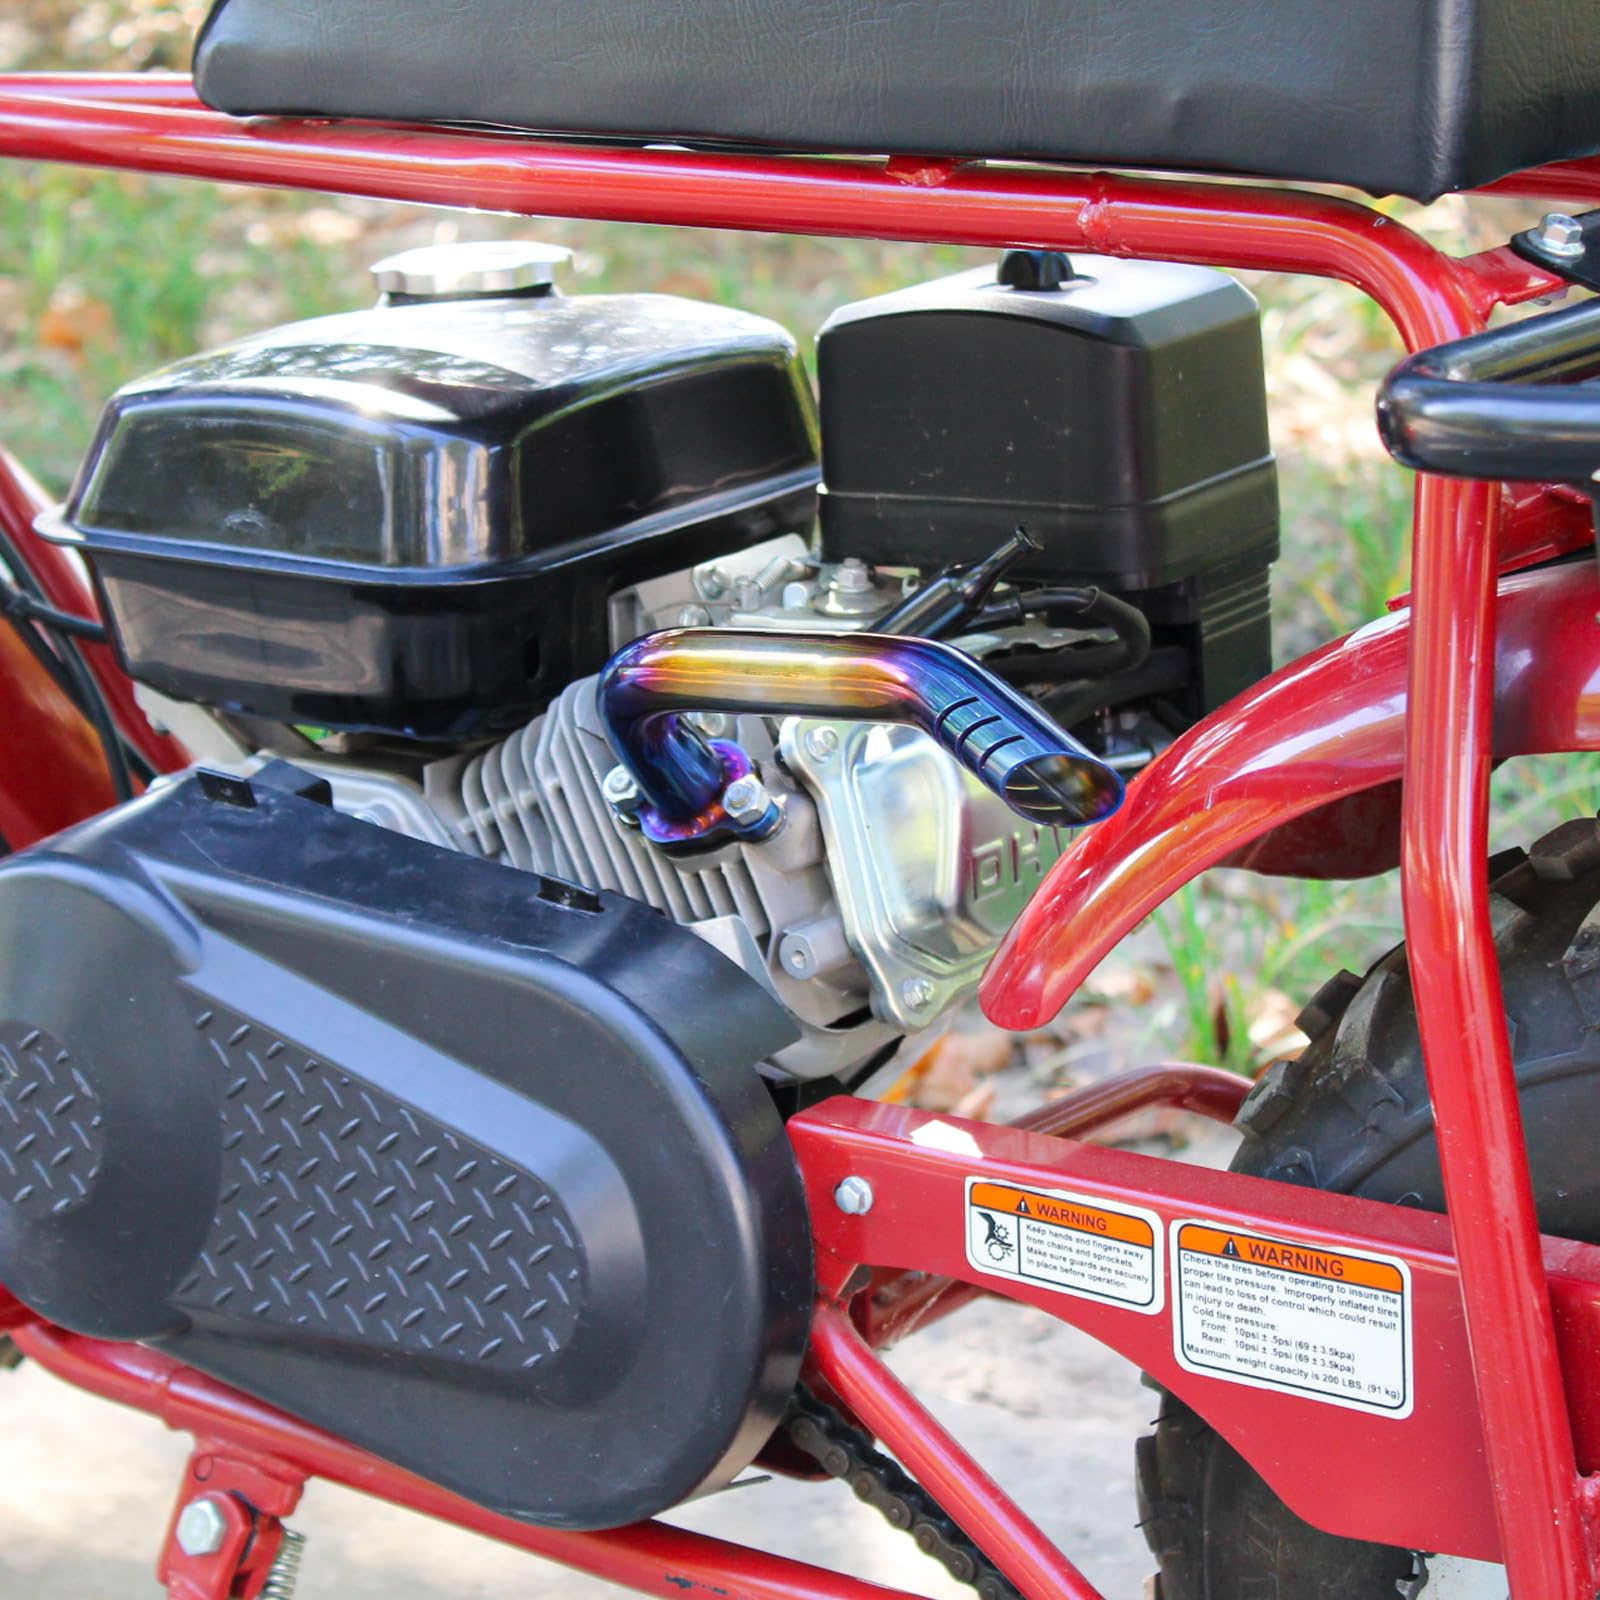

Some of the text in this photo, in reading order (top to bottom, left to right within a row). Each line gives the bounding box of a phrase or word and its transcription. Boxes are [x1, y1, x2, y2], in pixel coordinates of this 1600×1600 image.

[1037, 1202, 1107, 1231] WARNING
[1026, 1224, 1144, 1260] Keep hands and fingers away
[1026, 1235, 1045, 1245] from
[1046, 1241, 1073, 1253] chains
[1076, 1248, 1091, 1257] and
[1026, 1246, 1149, 1284] Make sure guards are securely
[1027, 1257, 1034, 1265] in
[1036, 1260, 1058, 1271] place
[1060, 1266, 1085, 1278] before
[1249, 1242, 1344, 1276] WARNING
[1183, 1252, 1398, 1304] Check the tires before operating to insure the
[1184, 1267, 1214, 1279] proper
[1216, 1273, 1232, 1283] tire
[1283, 1287, 1336, 1306] Improperly
[1339, 1298, 1375, 1313] inflated
[1377, 1305, 1399, 1318] tires
[1184, 1290, 1193, 1300] in
[1195, 1293, 1221, 1308] injury
[1224, 1300, 1234, 1308] or
[1184, 1279, 1397, 1331] can lead to loss of control which could result
[1192, 1305, 1214, 1318] Cold
[1216, 1311, 1232, 1321] tire
[1235, 1327, 1259, 1339] 10psi
[1235, 1340, 1259, 1352] 10psi
[1186, 1343, 1231, 1360] Maximum
[1236, 1356, 1266, 1368] weight
[1269, 1363, 1308, 1379] capacity
[1312, 1371, 1320, 1380] is
[1322, 1374, 1339, 1384] 200
[1367, 1384, 1381, 1394] (91
[1385, 1387, 1400, 1399] kg)
